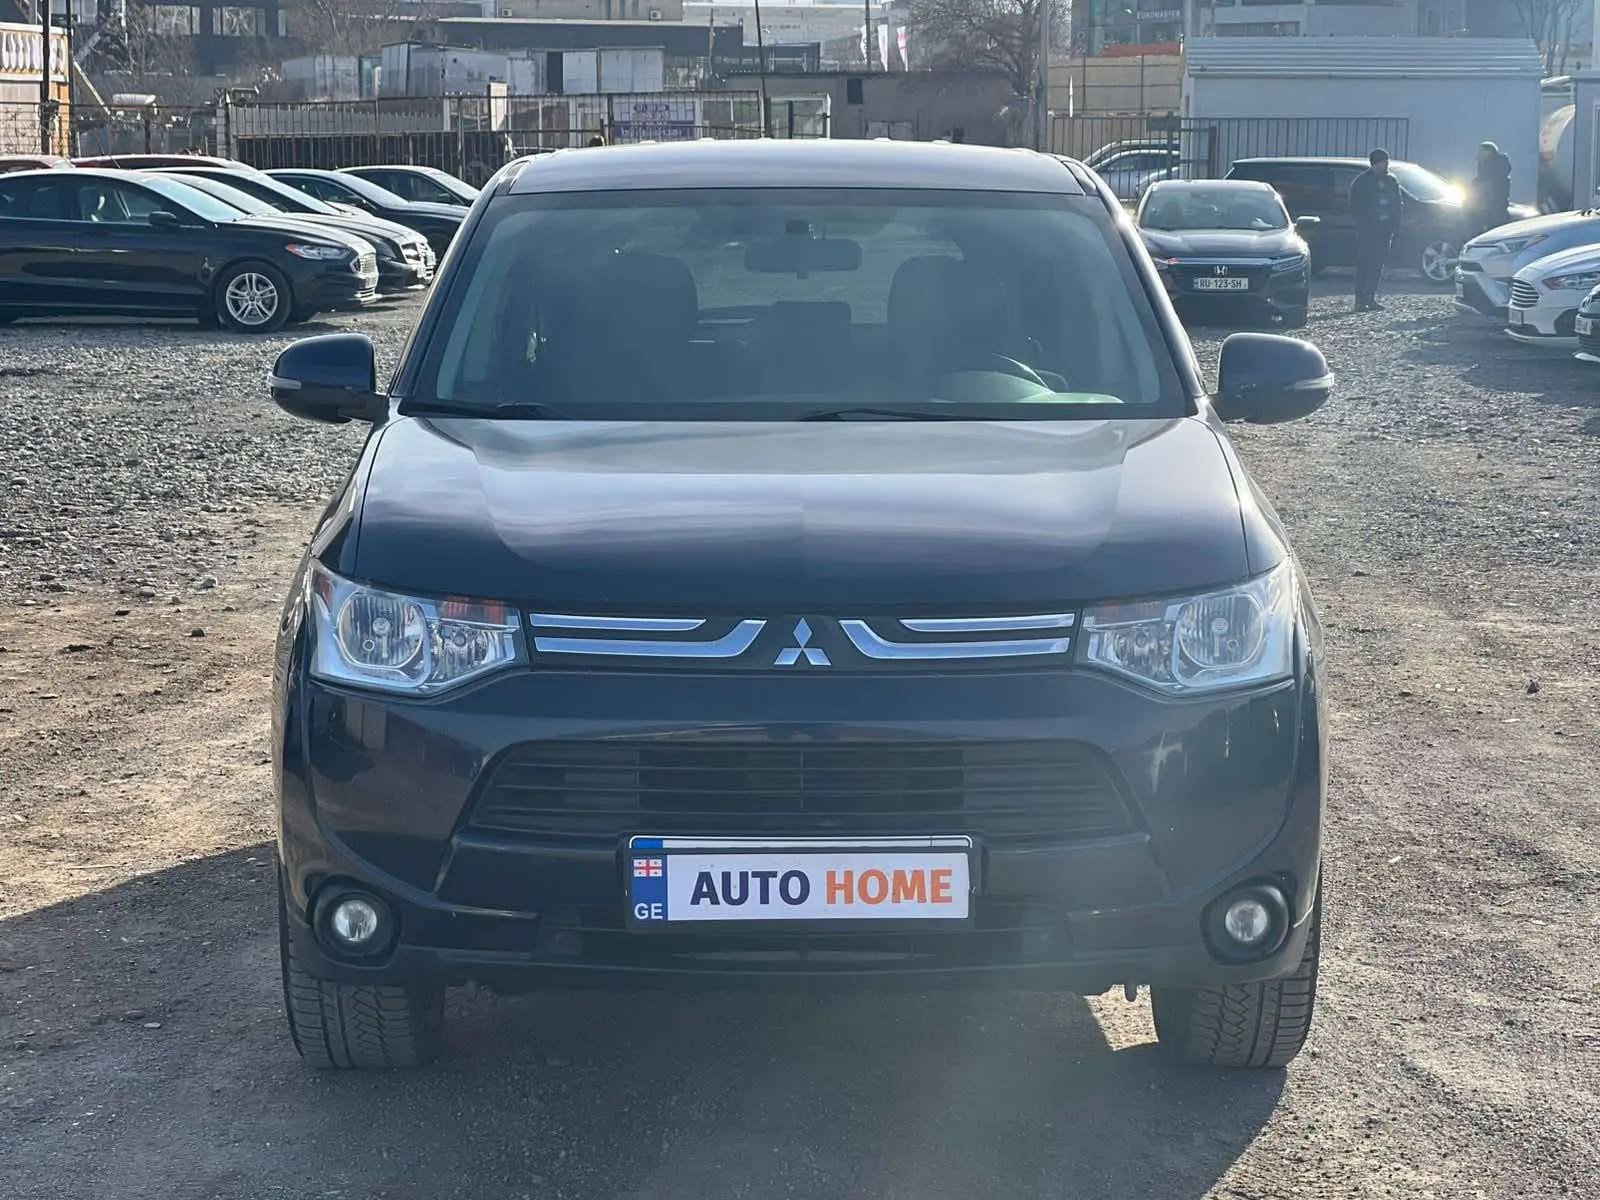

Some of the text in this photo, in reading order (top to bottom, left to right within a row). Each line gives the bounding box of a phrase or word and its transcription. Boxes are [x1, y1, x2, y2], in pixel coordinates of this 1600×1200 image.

[690, 869, 953, 905] AUTO HOME
[634, 902, 664, 920] GE
